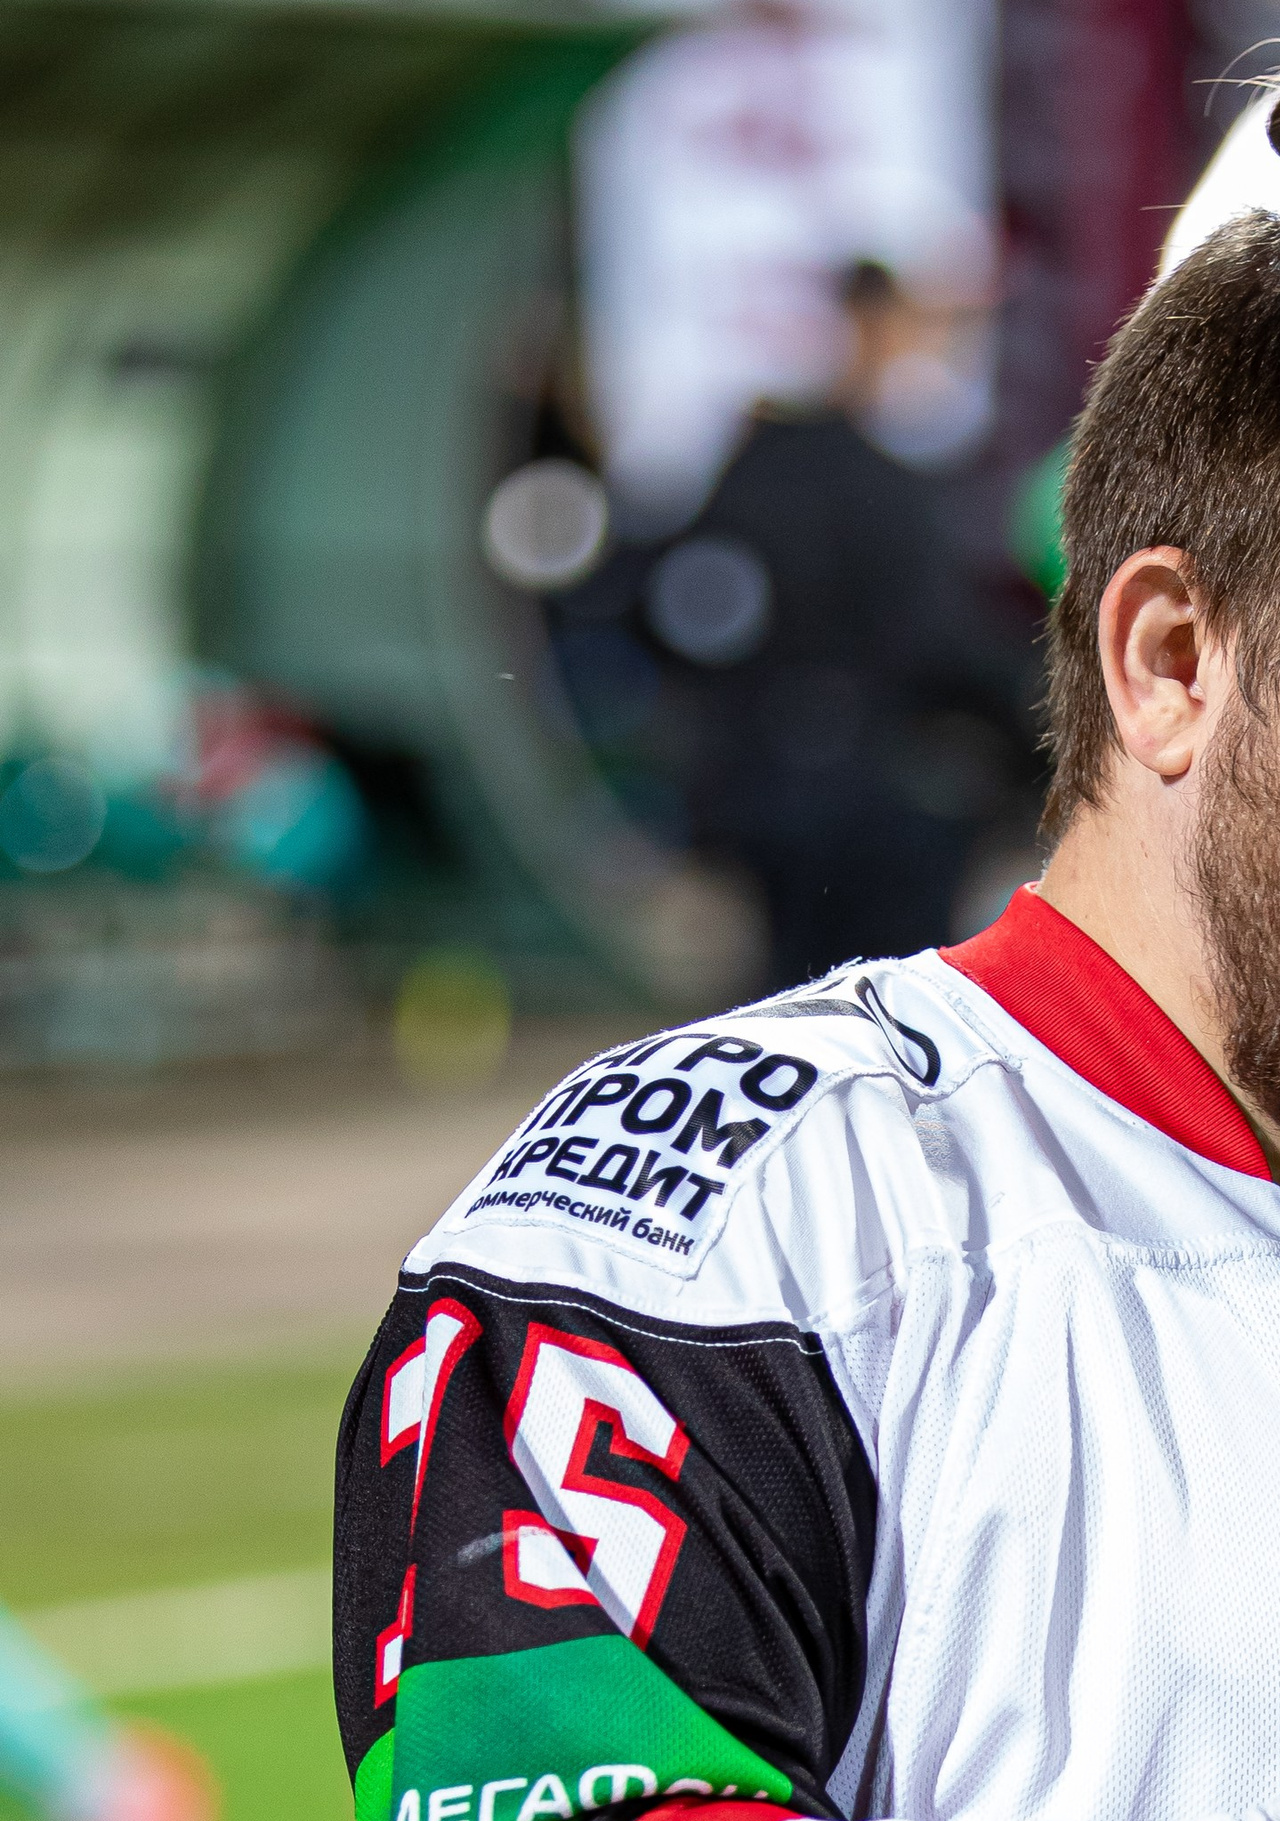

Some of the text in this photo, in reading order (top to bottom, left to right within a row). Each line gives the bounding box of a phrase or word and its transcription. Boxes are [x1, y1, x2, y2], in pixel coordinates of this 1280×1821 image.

[517, 1072, 771, 1169] ПРОМ
[482, 1136, 725, 1221] КРЕДИТ
[631, 1217, 696, 1255] банк
